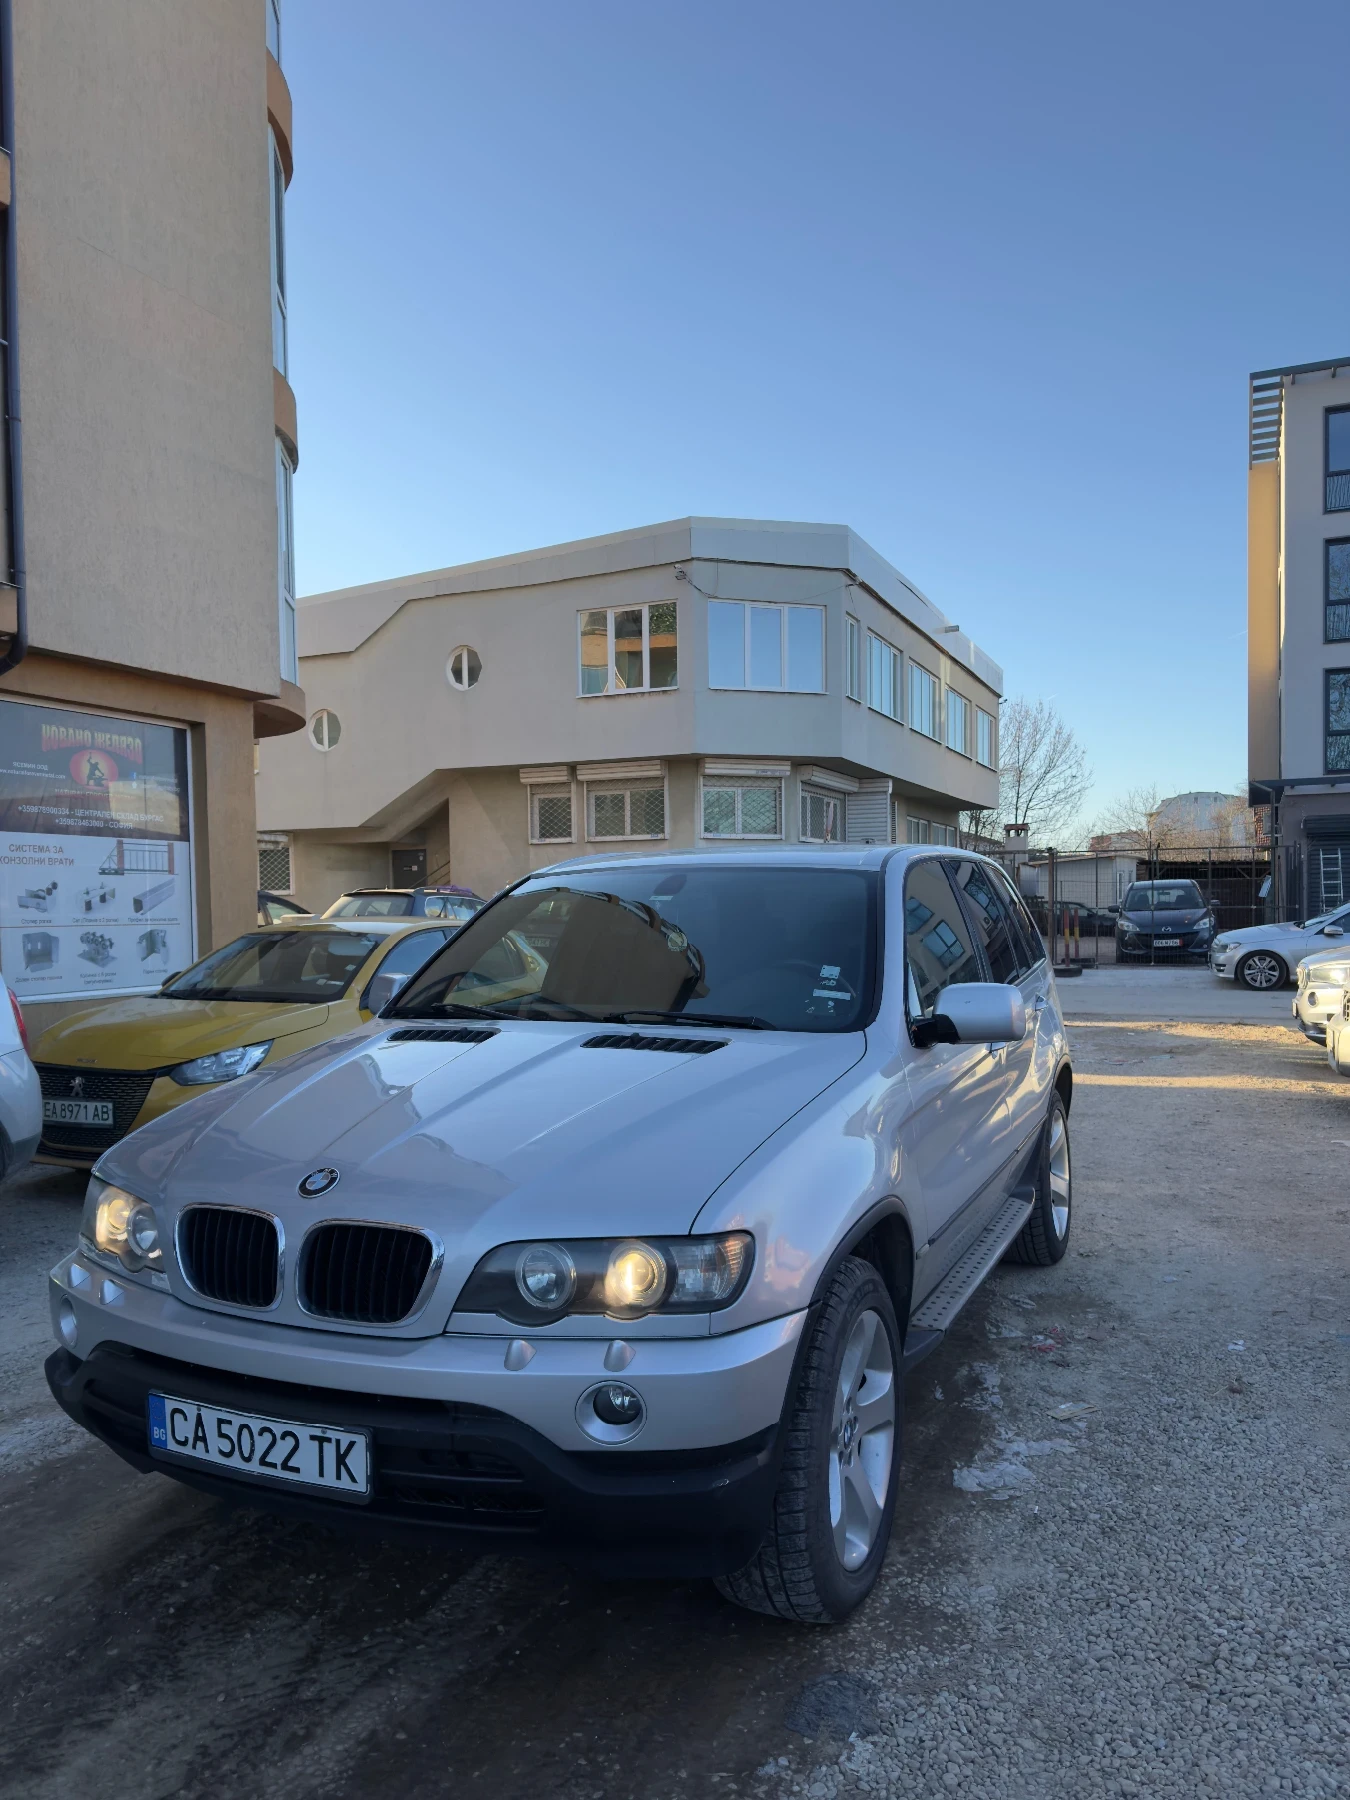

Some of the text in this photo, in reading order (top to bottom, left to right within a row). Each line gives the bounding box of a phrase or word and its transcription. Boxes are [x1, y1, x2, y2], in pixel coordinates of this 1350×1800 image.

[74, 808, 116, 820] ЦЕНТРАЛЕН
[109, 821, 133, 830] СОФИЯ
[8, 843, 64, 854] СИСТЕМА ЗА
[47, 857, 75, 866] ВРАТИ
[44, 1102, 110, 1121] EA 8971 AB
[153, 1426, 166, 1441] BG
[169, 1407, 359, 1484] CA 5022 TK
